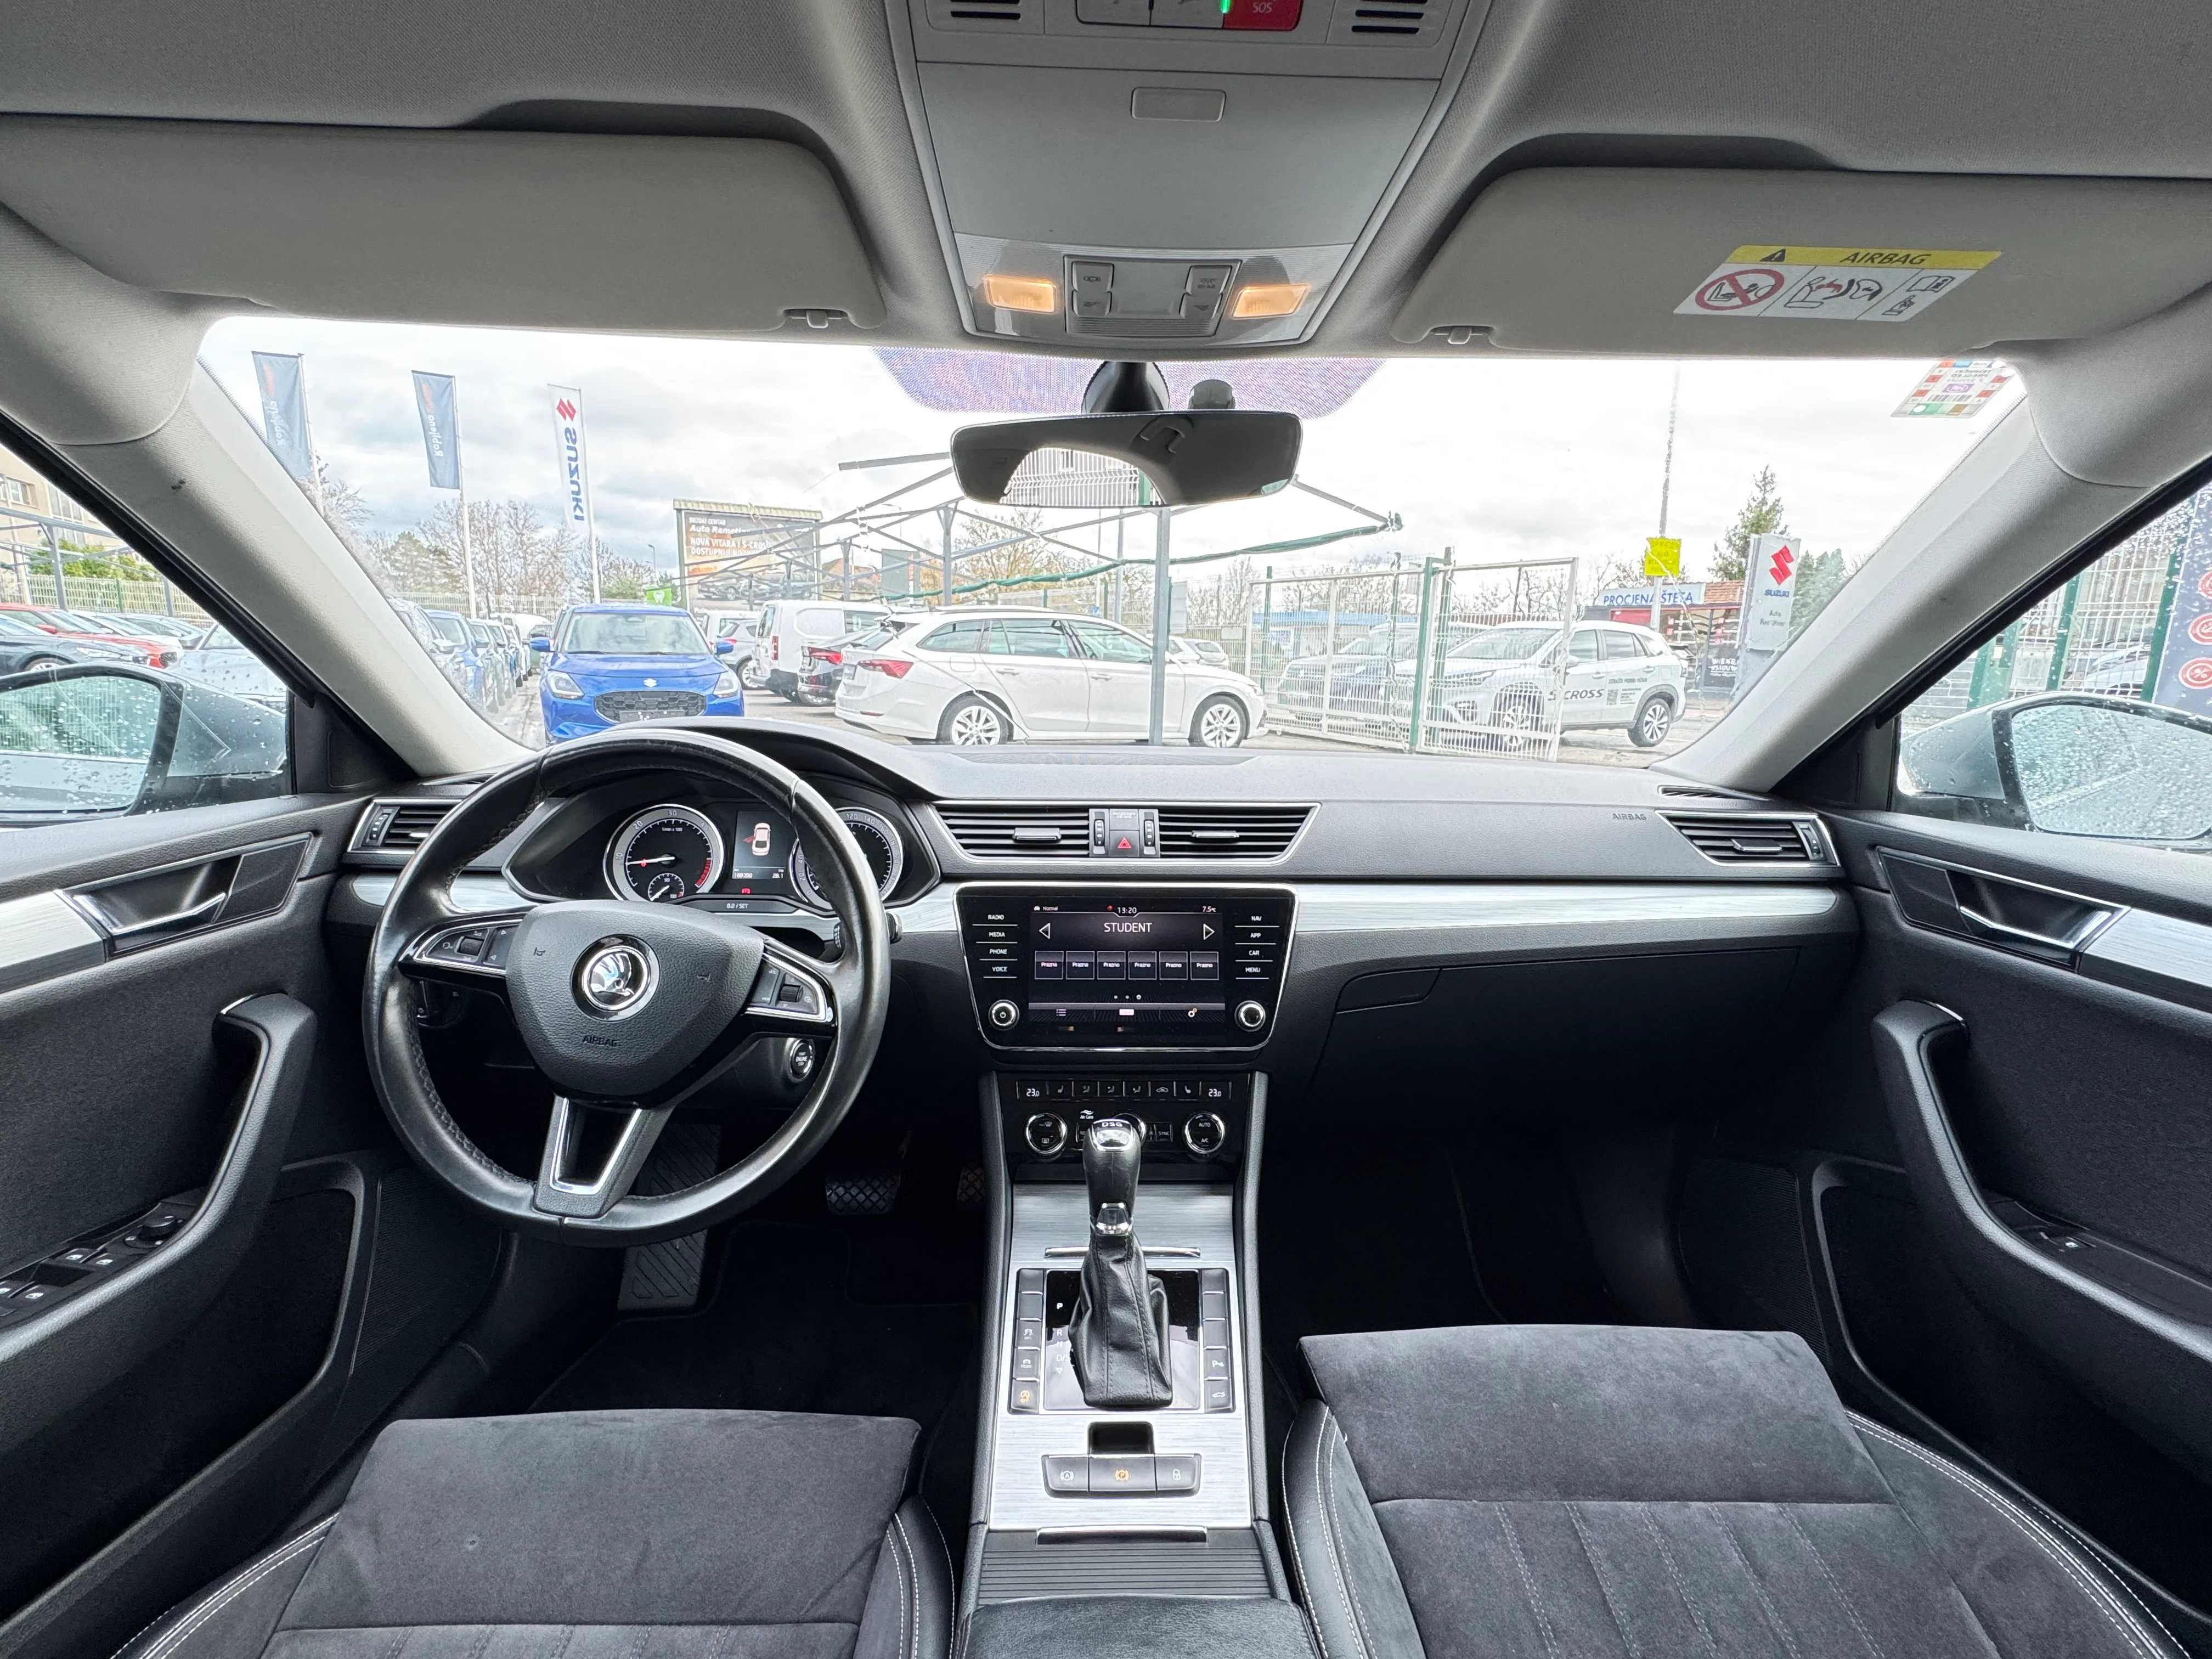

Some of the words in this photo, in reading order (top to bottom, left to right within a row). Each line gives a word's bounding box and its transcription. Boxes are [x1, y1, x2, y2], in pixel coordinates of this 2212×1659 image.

[1252, 2, 1272, 13] SOS
[1839, 252, 1931, 264] AIRBAG
[691, 537, 710, 546] NOVA
[712, 538, 736, 548] VITARA
[1547, 689, 1605, 701] SCROSS
[864, 815, 876, 825] 140
[1612, 812, 1647, 821] AIRBAG
[633, 820, 643, 830] 20
[879, 823, 889, 834] 160
[616, 852, 624, 860] 10
[798, 855, 804, 864] 40
[798, 873, 806, 881] 20
[1104, 922, 1153, 933] STUDENT
[582, 1035, 618, 1047] AIRBAG
[1026, 1088, 1040, 1097] 23.0
